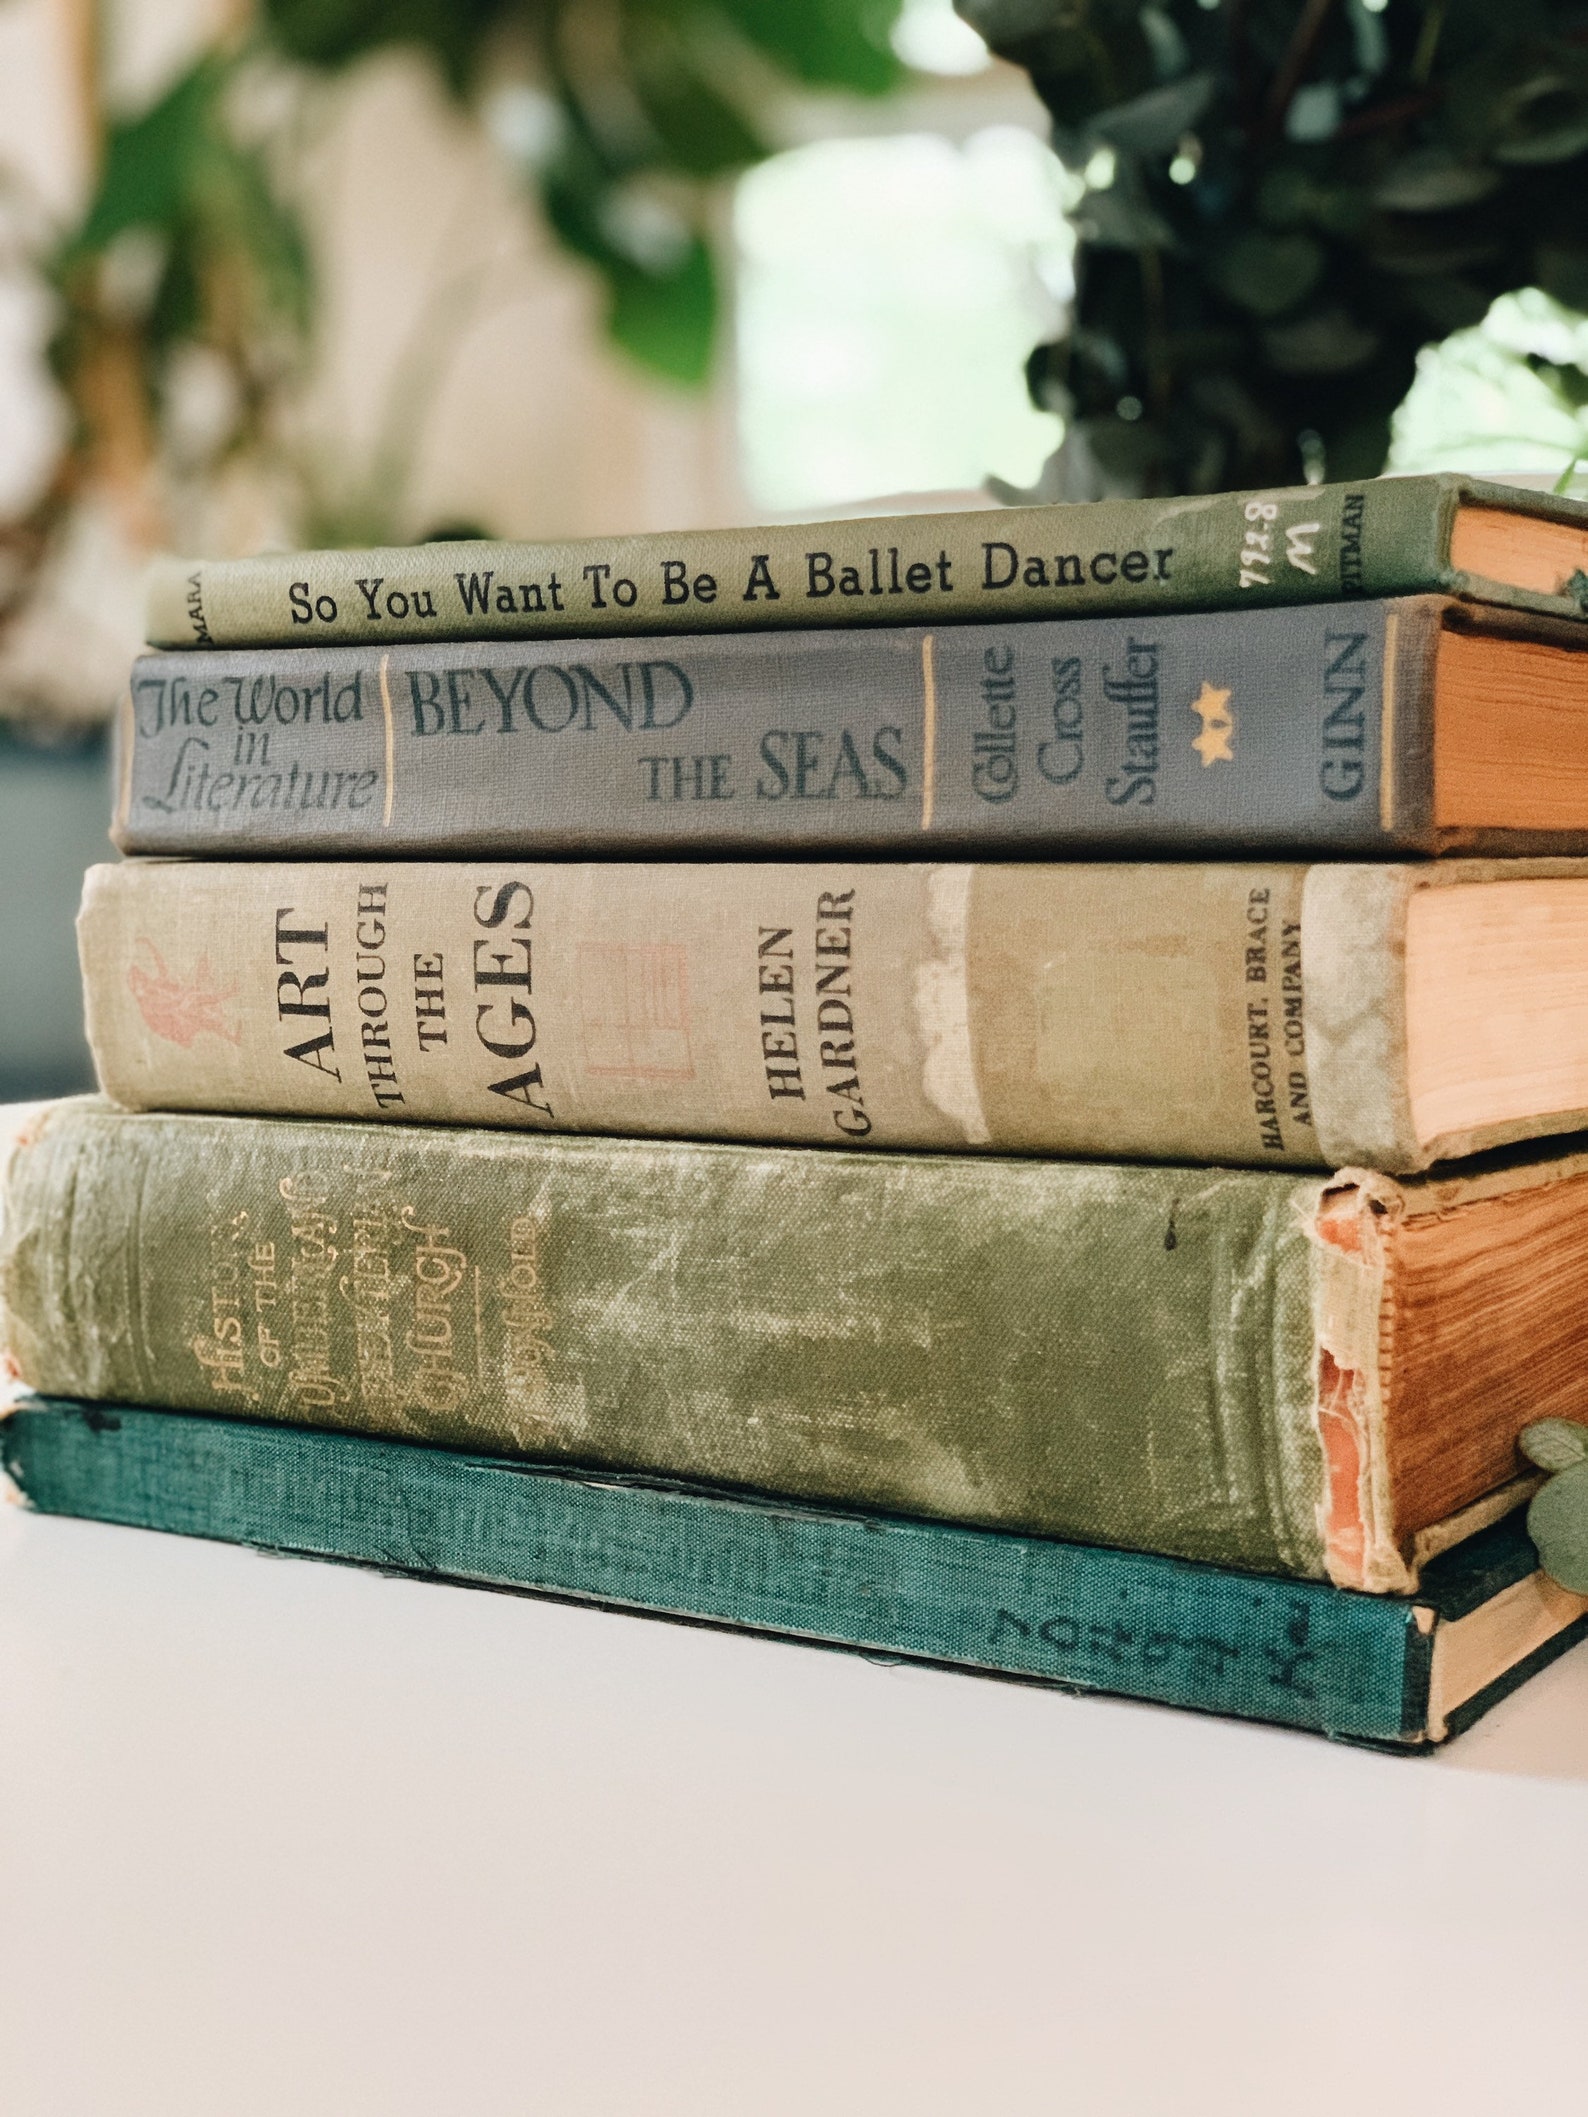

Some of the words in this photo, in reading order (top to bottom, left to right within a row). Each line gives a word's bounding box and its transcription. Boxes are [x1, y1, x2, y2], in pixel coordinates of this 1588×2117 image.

[184, 570, 215, 645] MARA
[288, 581, 338, 625] So
[354, 577, 438, 621] You
[455, 570, 564, 616] Want
[582, 564, 639, 608] To
[660, 559, 718, 606] Be
[742, 554, 781, 602] A
[805, 546, 954, 599] Ballet
[980, 541, 1175, 592] Dancer
[137, 672, 219, 738] The
[227, 669, 364, 726] World
[232, 725, 272, 767] in
[404, 660, 695, 737] BEYOND
[971, 643, 1019, 805] Collette
[1036, 655, 1085, 786] Cross
[1102, 637, 1162, 807] Stauffer
[1318, 628, 1369, 802] GINN
[143, 737, 379, 815] Literature
[638, 752, 736, 802] THE
[756, 726, 909, 802] SEAS
[1245, 886, 1272, 983] BRACE
[275, 907, 342, 1084] ART
[355, 881, 406, 1110] THROUGH
[413, 951, 448, 1053] THE
[473, 880, 555, 1119] AGES
[758, 924, 806, 1102] HELEN
[814, 887, 873, 1138] GARDNER
[1280, 917, 1306, 1057] COMPANY
[1288, 1071, 1313, 1127] AND
[248, 1240, 278, 1313] THE
[257, 1323, 284, 1369] OF
